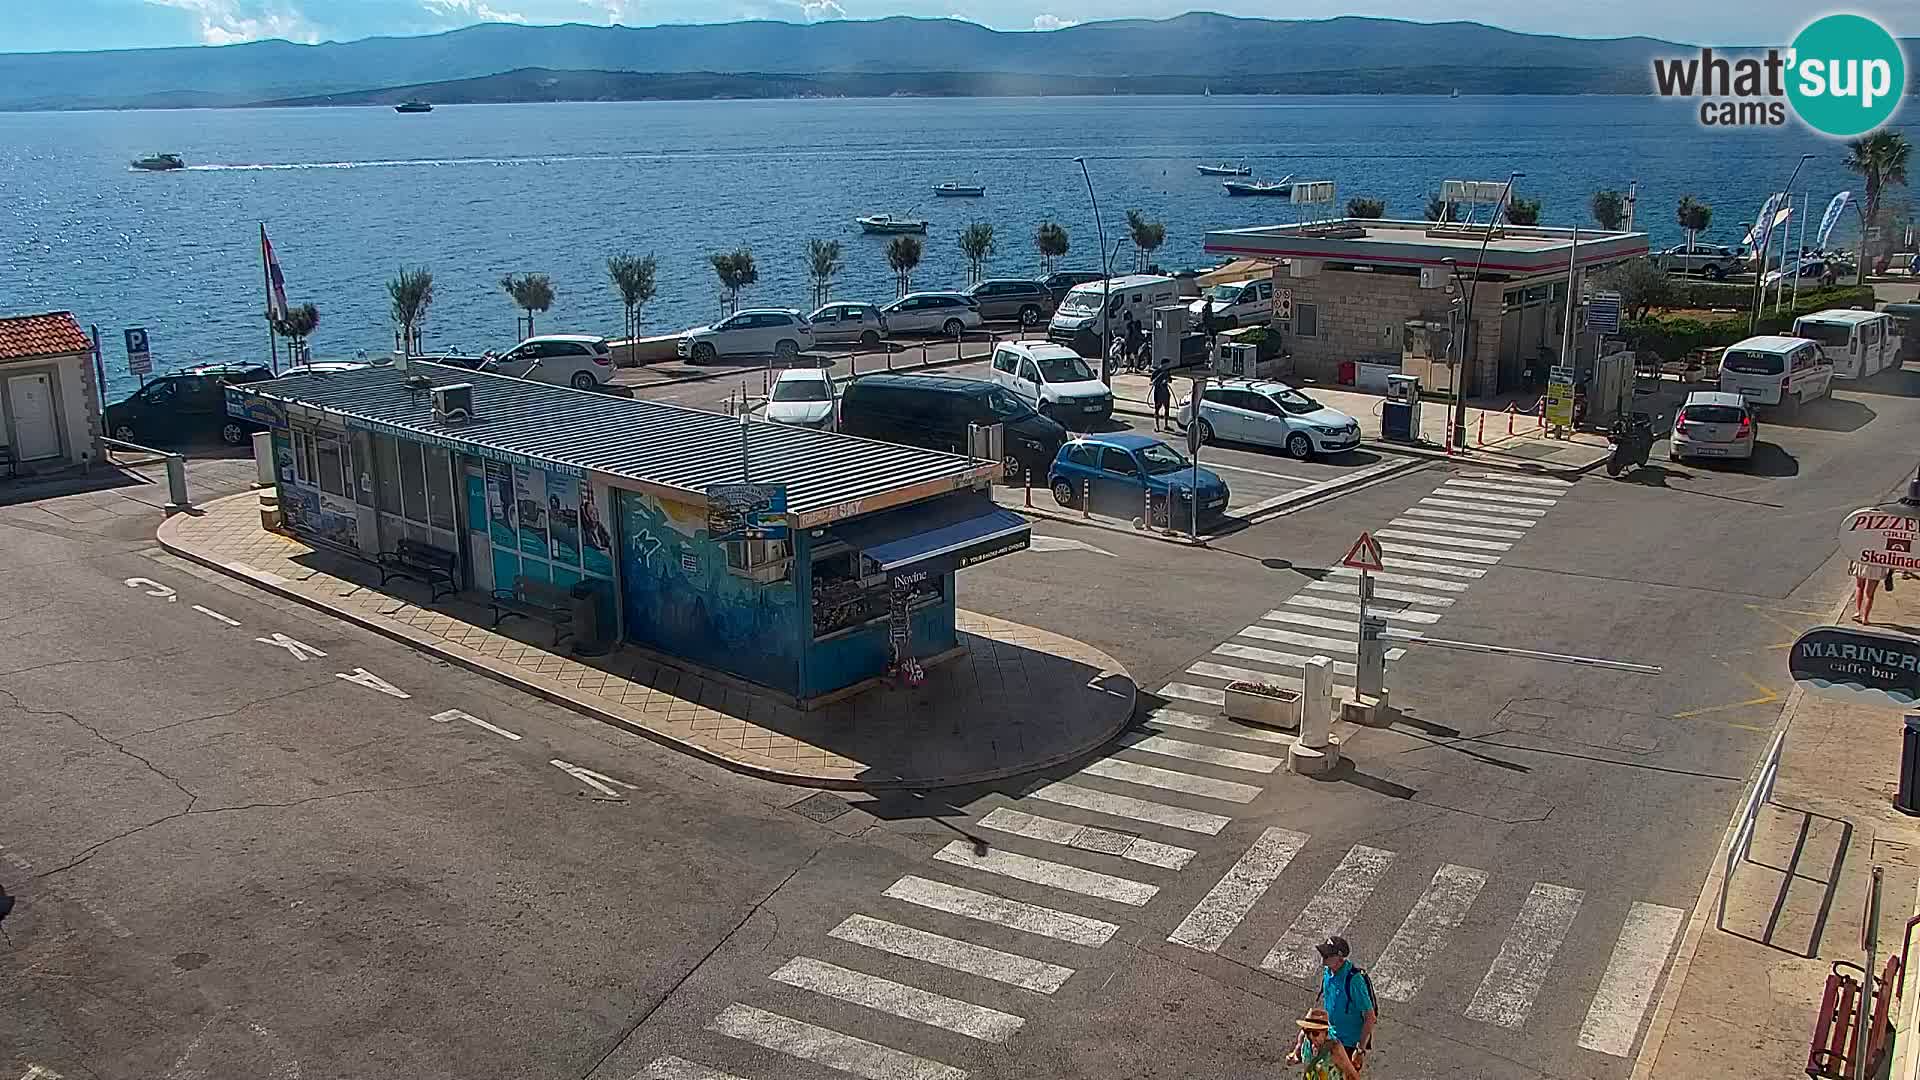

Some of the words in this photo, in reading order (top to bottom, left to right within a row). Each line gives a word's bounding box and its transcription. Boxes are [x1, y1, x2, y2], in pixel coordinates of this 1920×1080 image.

[129, 331, 143, 350] P
[1746, 351, 1764, 360] TAXI
[478, 446, 493, 458] BUS
[494, 450, 527, 465] STATION
[529, 457, 555, 471] TICKET
[555, 463, 583, 478] OFFICE
[1848, 515, 1920, 533] PIZZE
[1882, 530, 1918, 540] GRILL
[1829, 662, 1866, 674] caffe
[1871, 665, 1898, 680] bar
